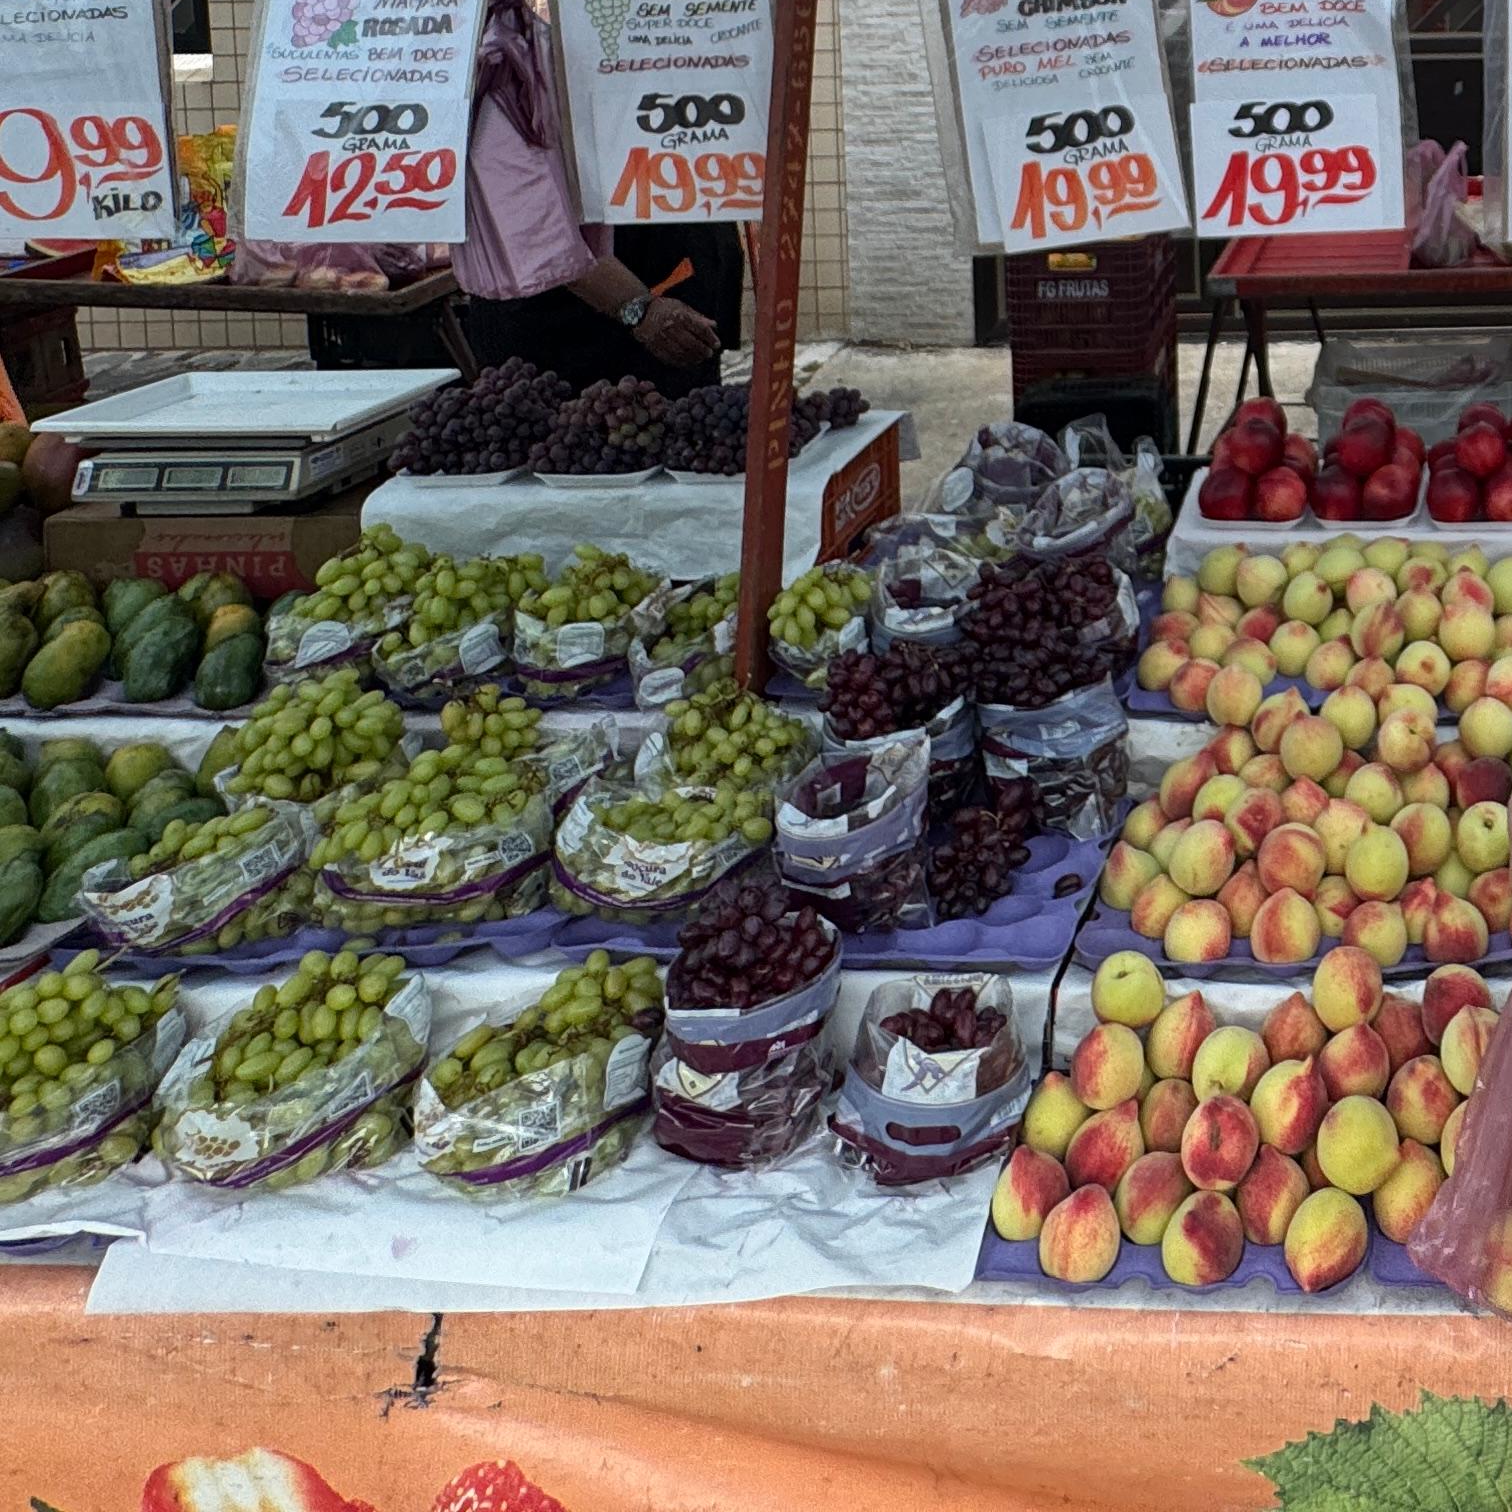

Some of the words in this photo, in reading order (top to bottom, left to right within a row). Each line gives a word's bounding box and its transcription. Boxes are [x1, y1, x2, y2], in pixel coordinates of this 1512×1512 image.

[637, 2, 671, 17] SEM
[1260, 2, 1309, 14] BEM
[1318, 0, 1366, 13] DOCE
[361, 14, 453, 38] ROSADA
[626, 18, 672, 30] SUPER
[677, 18, 714, 29] DOCE
[996, 17, 1029, 33] SEM
[1243, 21, 1279, 31] UMA
[975, 29, 1132, 63] SELECIONADAS
[1239, 37, 1250, 47] A
[1261, 33, 1332, 47] MELHOR
[367, 48, 401, 61] BEM
[411, 47, 454, 62] DOCE
[597, 54, 751, 74] SELECIONADAS
[1208, 55, 1368, 72] SELECIONADAS
[282, 65, 449, 84] SELECIONADAS
[978, 61, 1027, 82] PURO
[1037, 55, 1077, 73] MEL
[311, 102, 429, 139] 500
[637, 92, 745, 133] 500
[1228, 99, 1334, 138] 500
[660, 128, 729, 150] GRAMA
[1025, 104, 1135, 154] 500
[1063, 138, 1130, 166] GRAMA
[1255, 135, 1313, 153] GRAMA
[92, 190, 163, 221] KILO
[1059, 280, 1109, 298] FRUTAS
[147, 555, 286, 578] PINHAS
